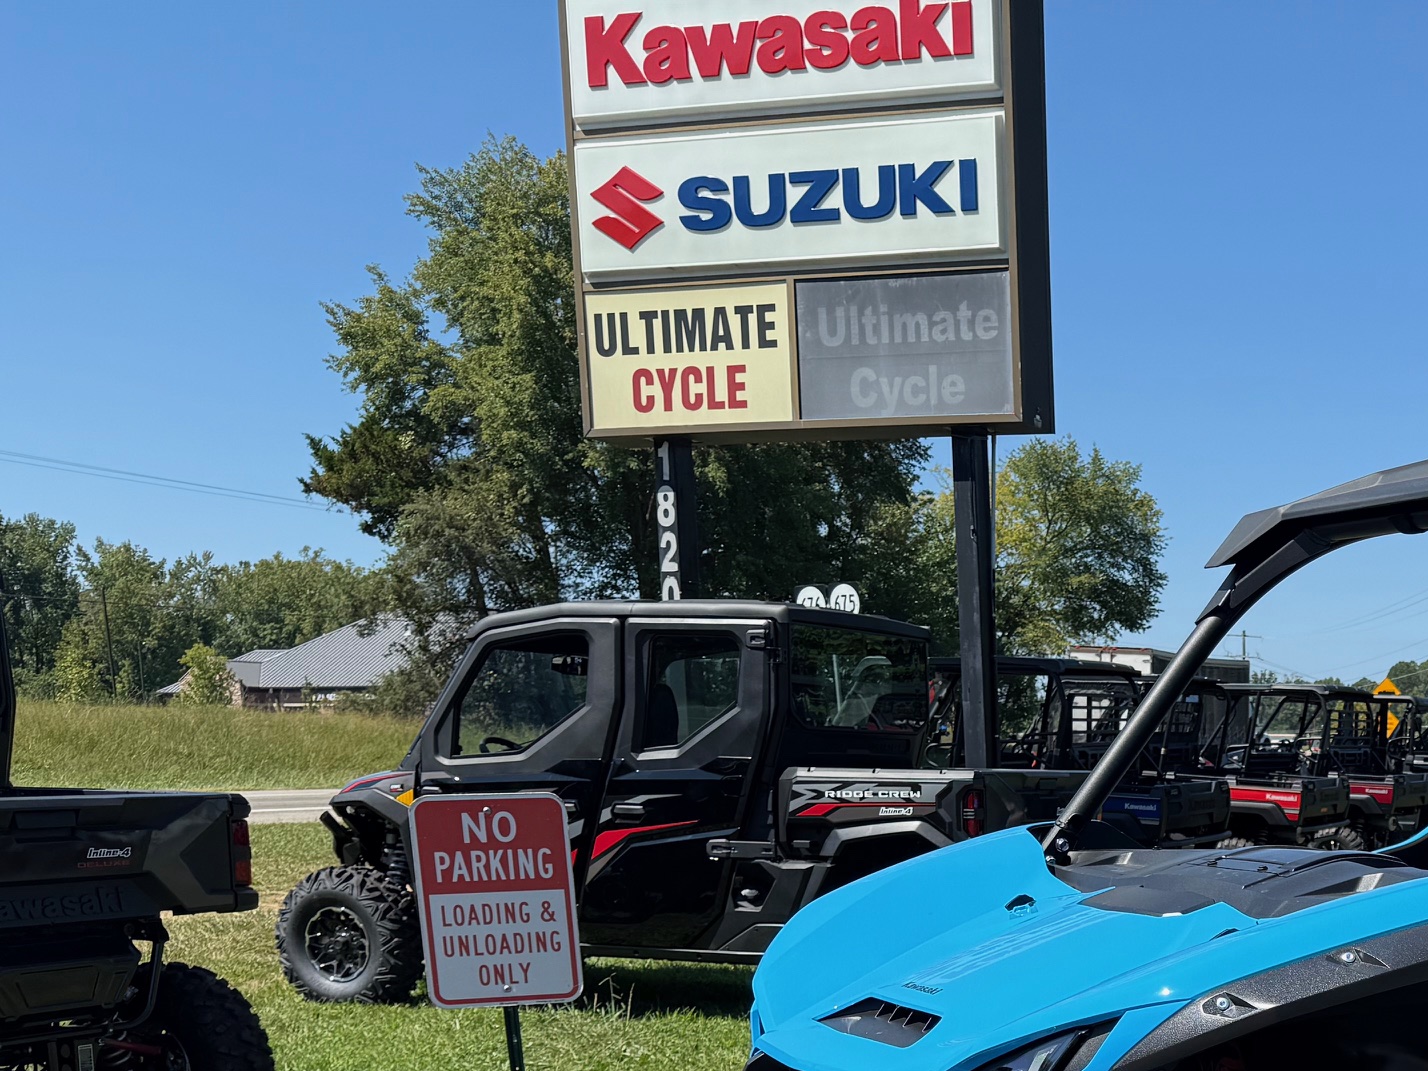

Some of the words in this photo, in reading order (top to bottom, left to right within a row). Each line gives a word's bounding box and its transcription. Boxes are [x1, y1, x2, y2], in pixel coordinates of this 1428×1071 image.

[584, 0, 974, 88] Kawasaki
[678, 158, 978, 231] SUZUKI
[593, 303, 778, 358] ULTIMATE
[818, 302, 999, 348] Ultimate
[632, 364, 748, 414] CYCLE
[850, 366, 966, 414] Cycle
[825, 790, 874, 798] RIDGE
[878, 790, 921, 798] CREW
[461, 811, 517, 844] NO
[434, 848, 554, 883] PARKING
[441, 901, 531, 927] LOADING
[541, 900, 556, 922] &
[442, 931, 562, 958] UNLOADING
[479, 962, 532, 986] ONLY
